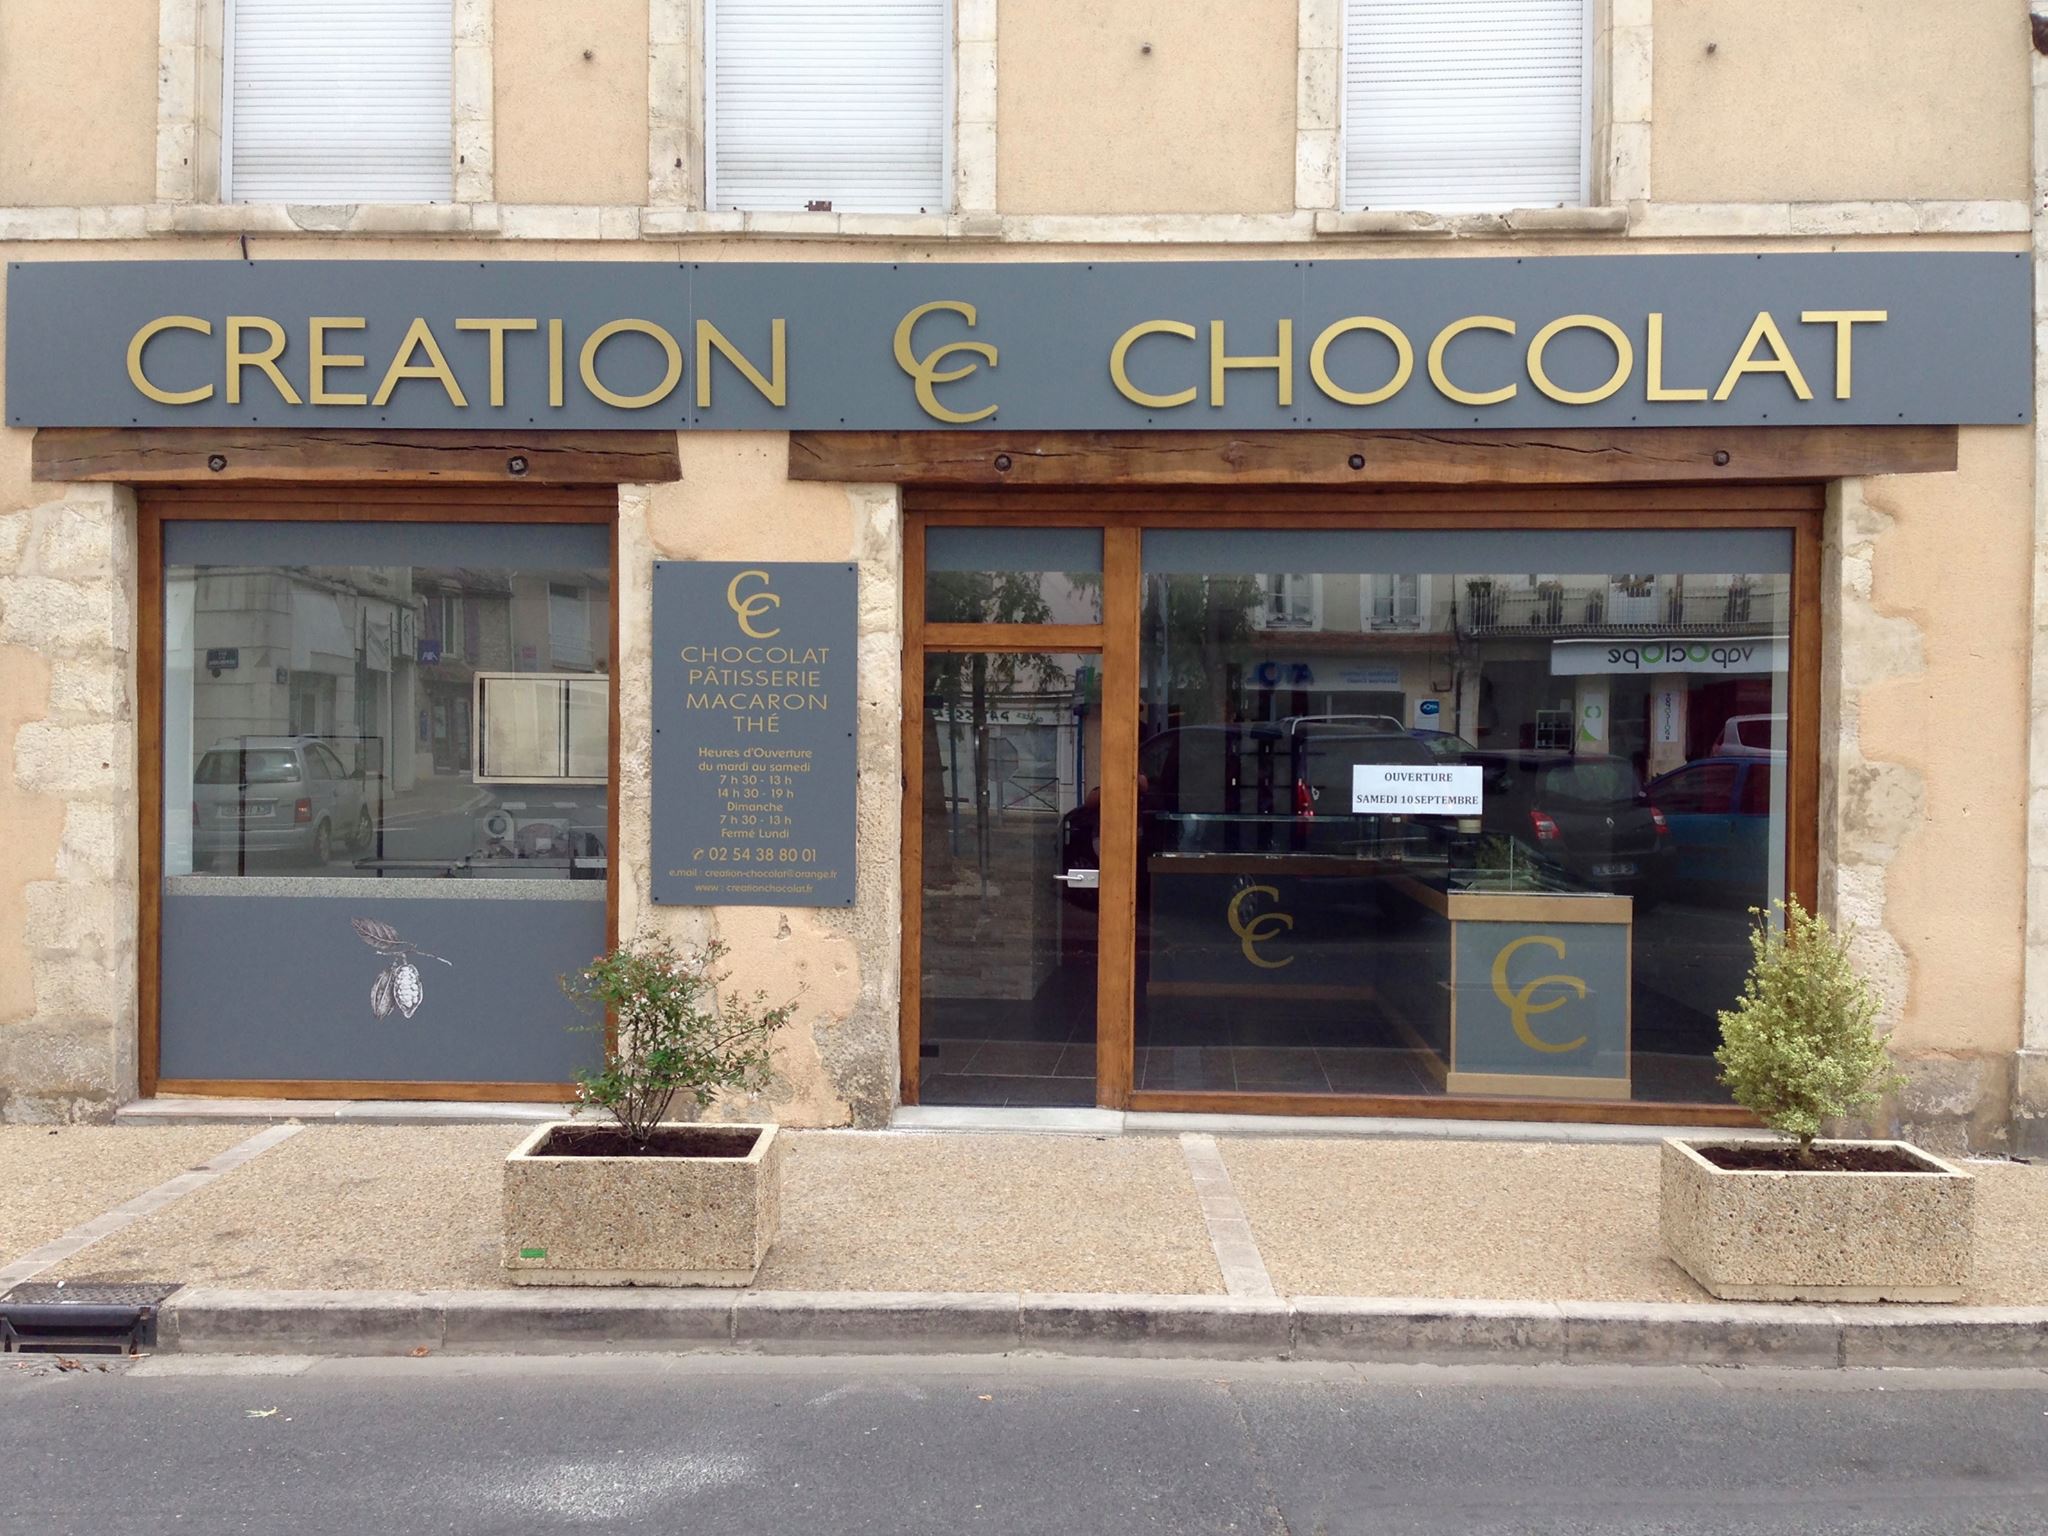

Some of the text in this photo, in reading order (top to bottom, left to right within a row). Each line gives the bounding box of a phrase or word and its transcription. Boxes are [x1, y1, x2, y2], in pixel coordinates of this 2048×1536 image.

[125, 315, 786, 409] CREATION
[1109, 309, 1888, 407] CHOCOLAT
[681, 646, 830, 664] CHOCOLAT
[689, 665, 821, 687] PÂTISSERIE
[686, 693, 828, 710] MACARON
[733, 712, 780, 733] THÉ
[698, 747, 813, 759] Heures d'Ouverture
[698, 762, 811, 772] du mardi au samedi
[720, 775, 726, 785] 7
[731, 775, 738, 785] h
[742, 775, 757, 785] 30
[769, 775, 781, 785] 13
[784, 775, 792, 785] h
[1384, 772, 1453, 782] OUVERTURE
[718, 788, 729, 798] 14
[733, 788, 739, 798] h
[744, 788, 759, 798] 30
[771, 788, 783, 798] 19
[787, 788, 794, 798] h
[1356, 794, 1479, 805] SAMEDI 10 SEPTEMBRE
[727, 802, 784, 812] Dimanche
[720, 815, 726, 825] 7
[730, 815, 738, 825] h
[742, 815, 757, 825] 30
[769, 815, 781, 825] 13
[784, 815, 792, 825] h
[721, 828, 790, 839] Fermé Lundi
[709, 847, 816, 863] 02 54 38 80 01
